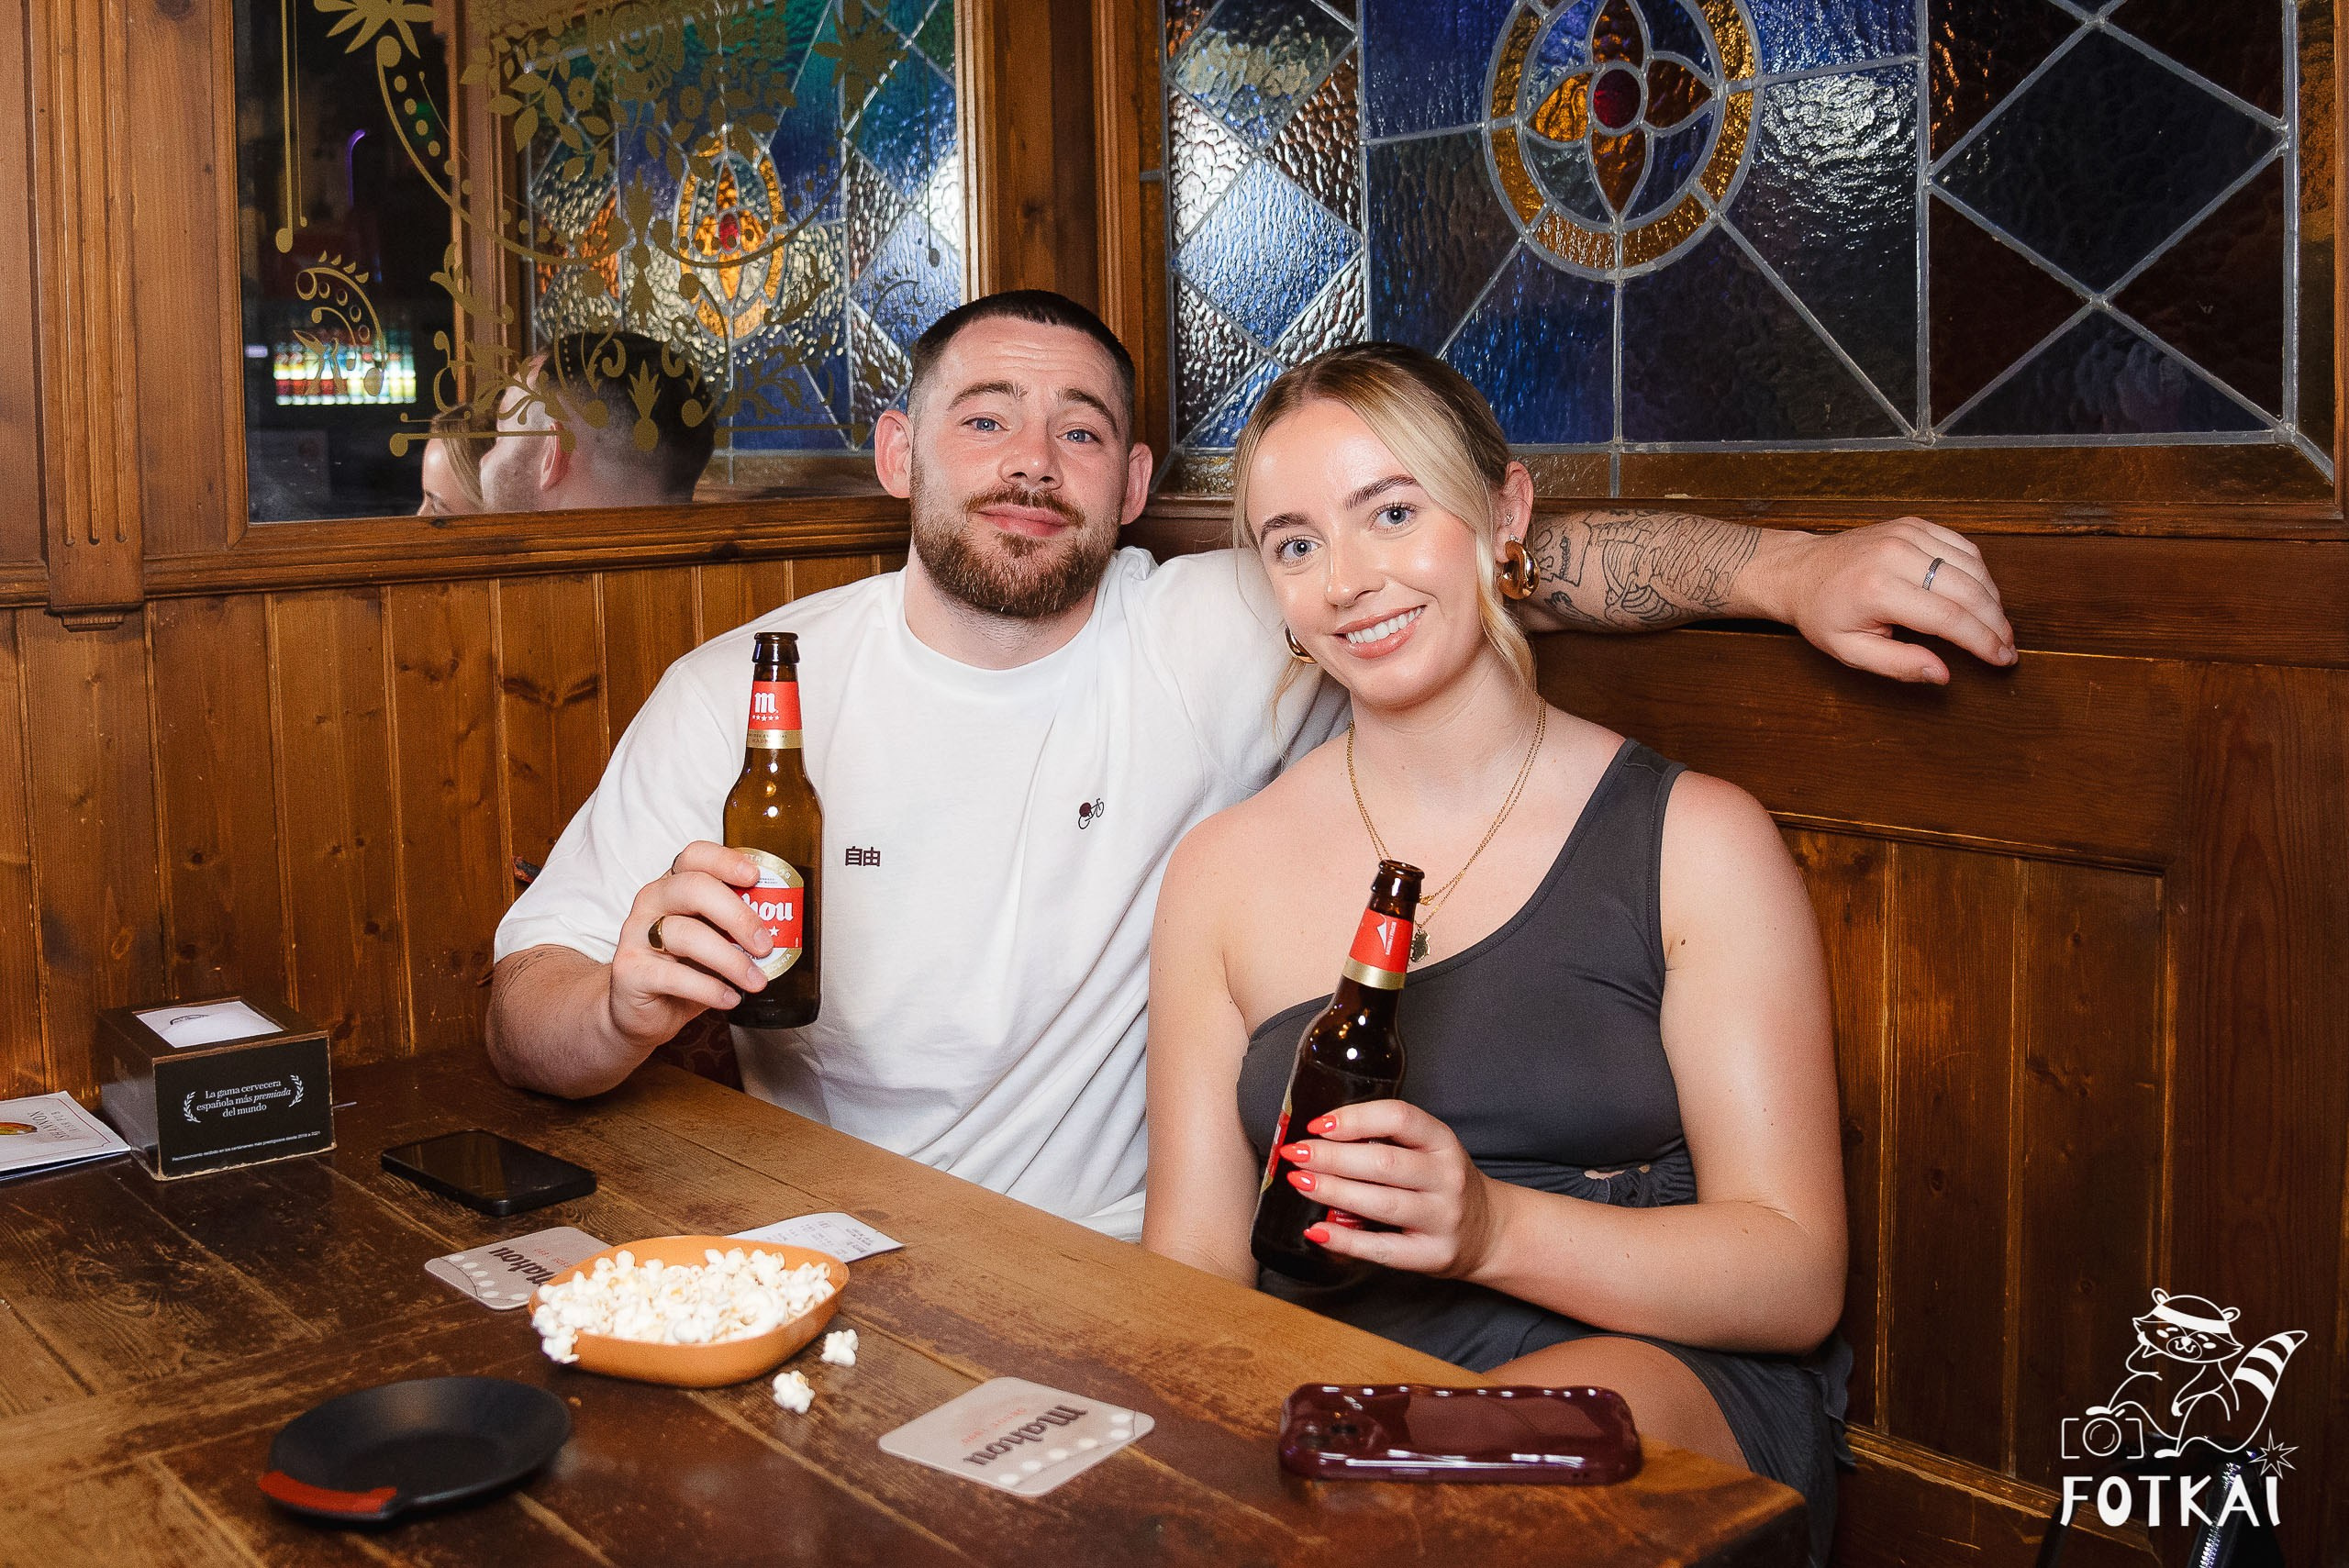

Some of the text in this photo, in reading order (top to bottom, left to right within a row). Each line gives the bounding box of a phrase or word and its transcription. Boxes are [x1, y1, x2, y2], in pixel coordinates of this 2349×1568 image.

[844, 846, 881, 867] 自由
[741, 893, 794, 922] hou
[195, 1087, 292, 1112] española más premiada
[205, 1080, 282, 1099] La gama cervecera
[222, 1103, 267, 1118] del mundo
